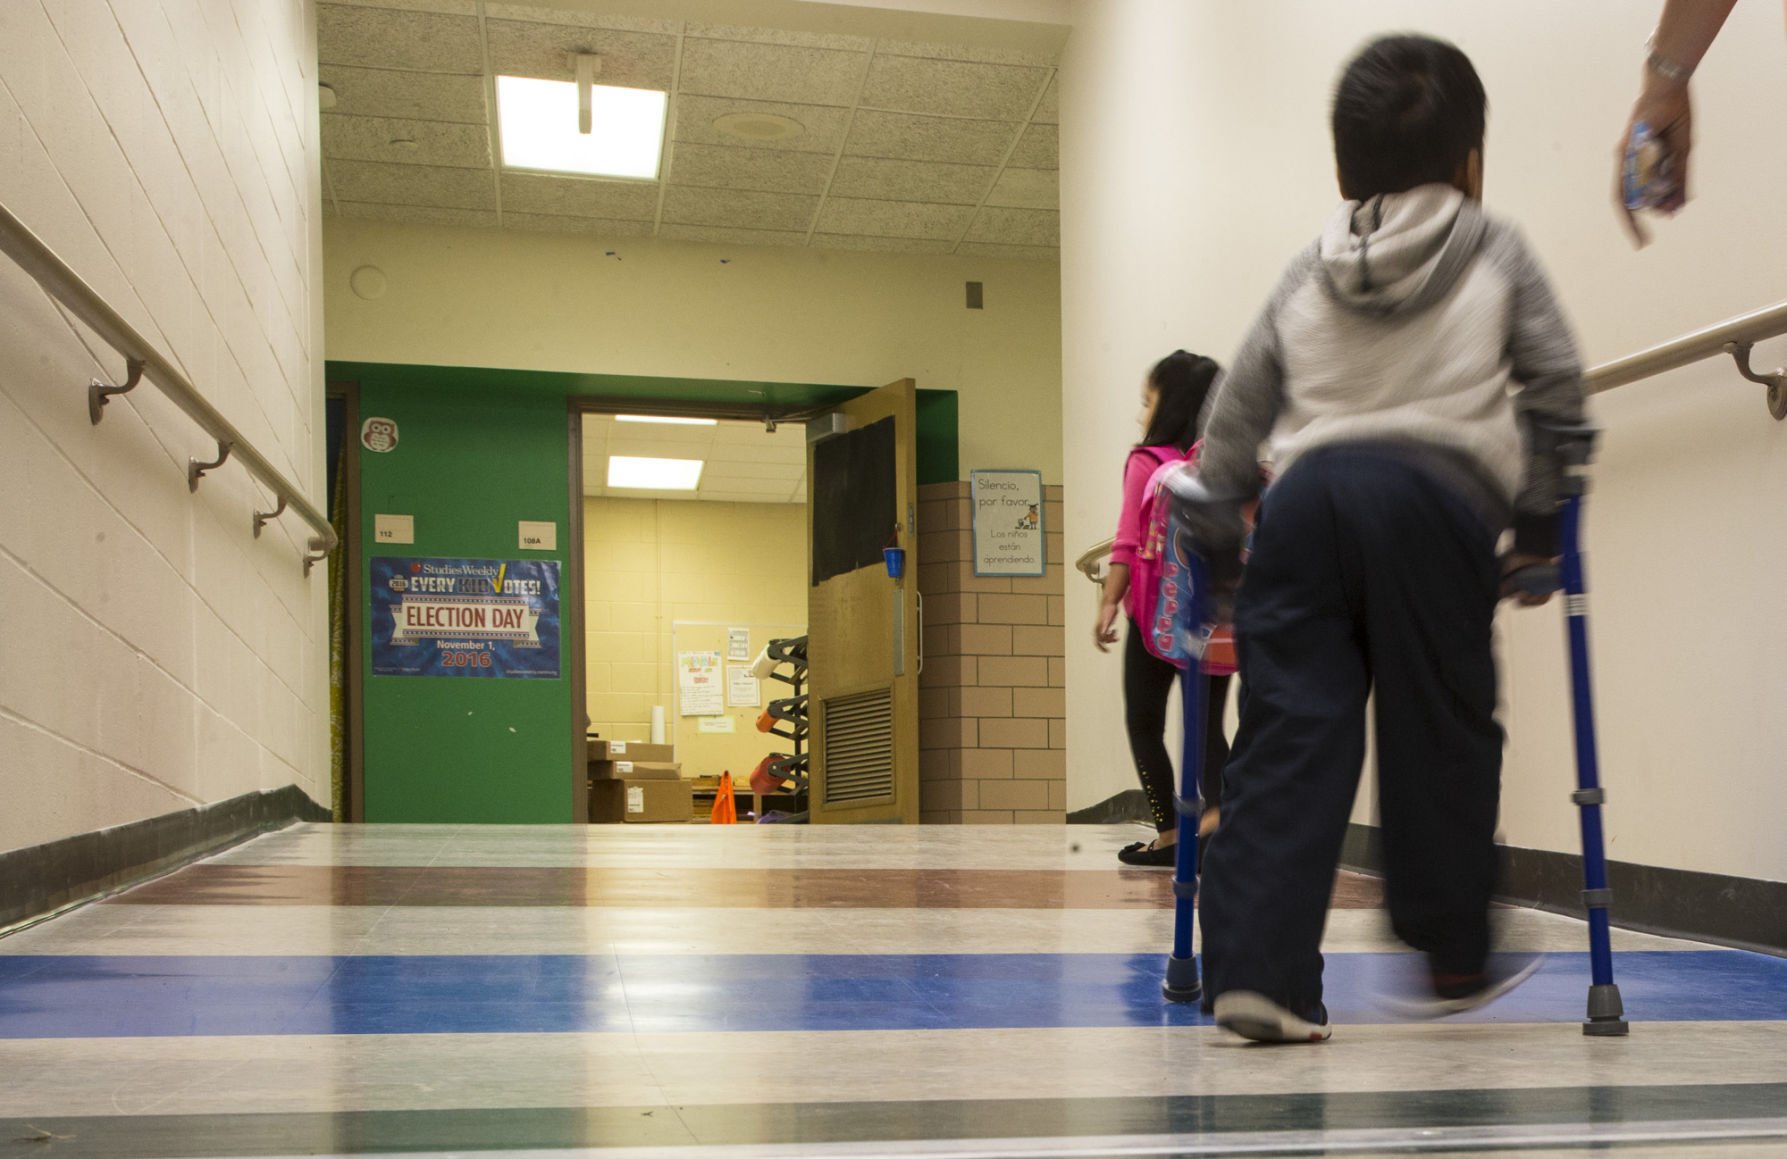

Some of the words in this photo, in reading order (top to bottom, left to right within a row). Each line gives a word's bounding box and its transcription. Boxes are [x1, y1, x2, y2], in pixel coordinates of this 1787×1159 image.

[977, 478, 1020, 492] Silencio,
[978, 498, 997, 511] por
[379, 530, 393, 538] 112
[990, 529, 1005, 539] Los
[1007, 529, 1028, 539] niños
[998, 542, 1022, 551] están
[411, 576, 456, 593] EVERY
[406, 605, 486, 628] ELECTION
[492, 607, 524, 629] DAY
[436, 640, 485, 650] November
[441, 651, 491, 667] 2016
